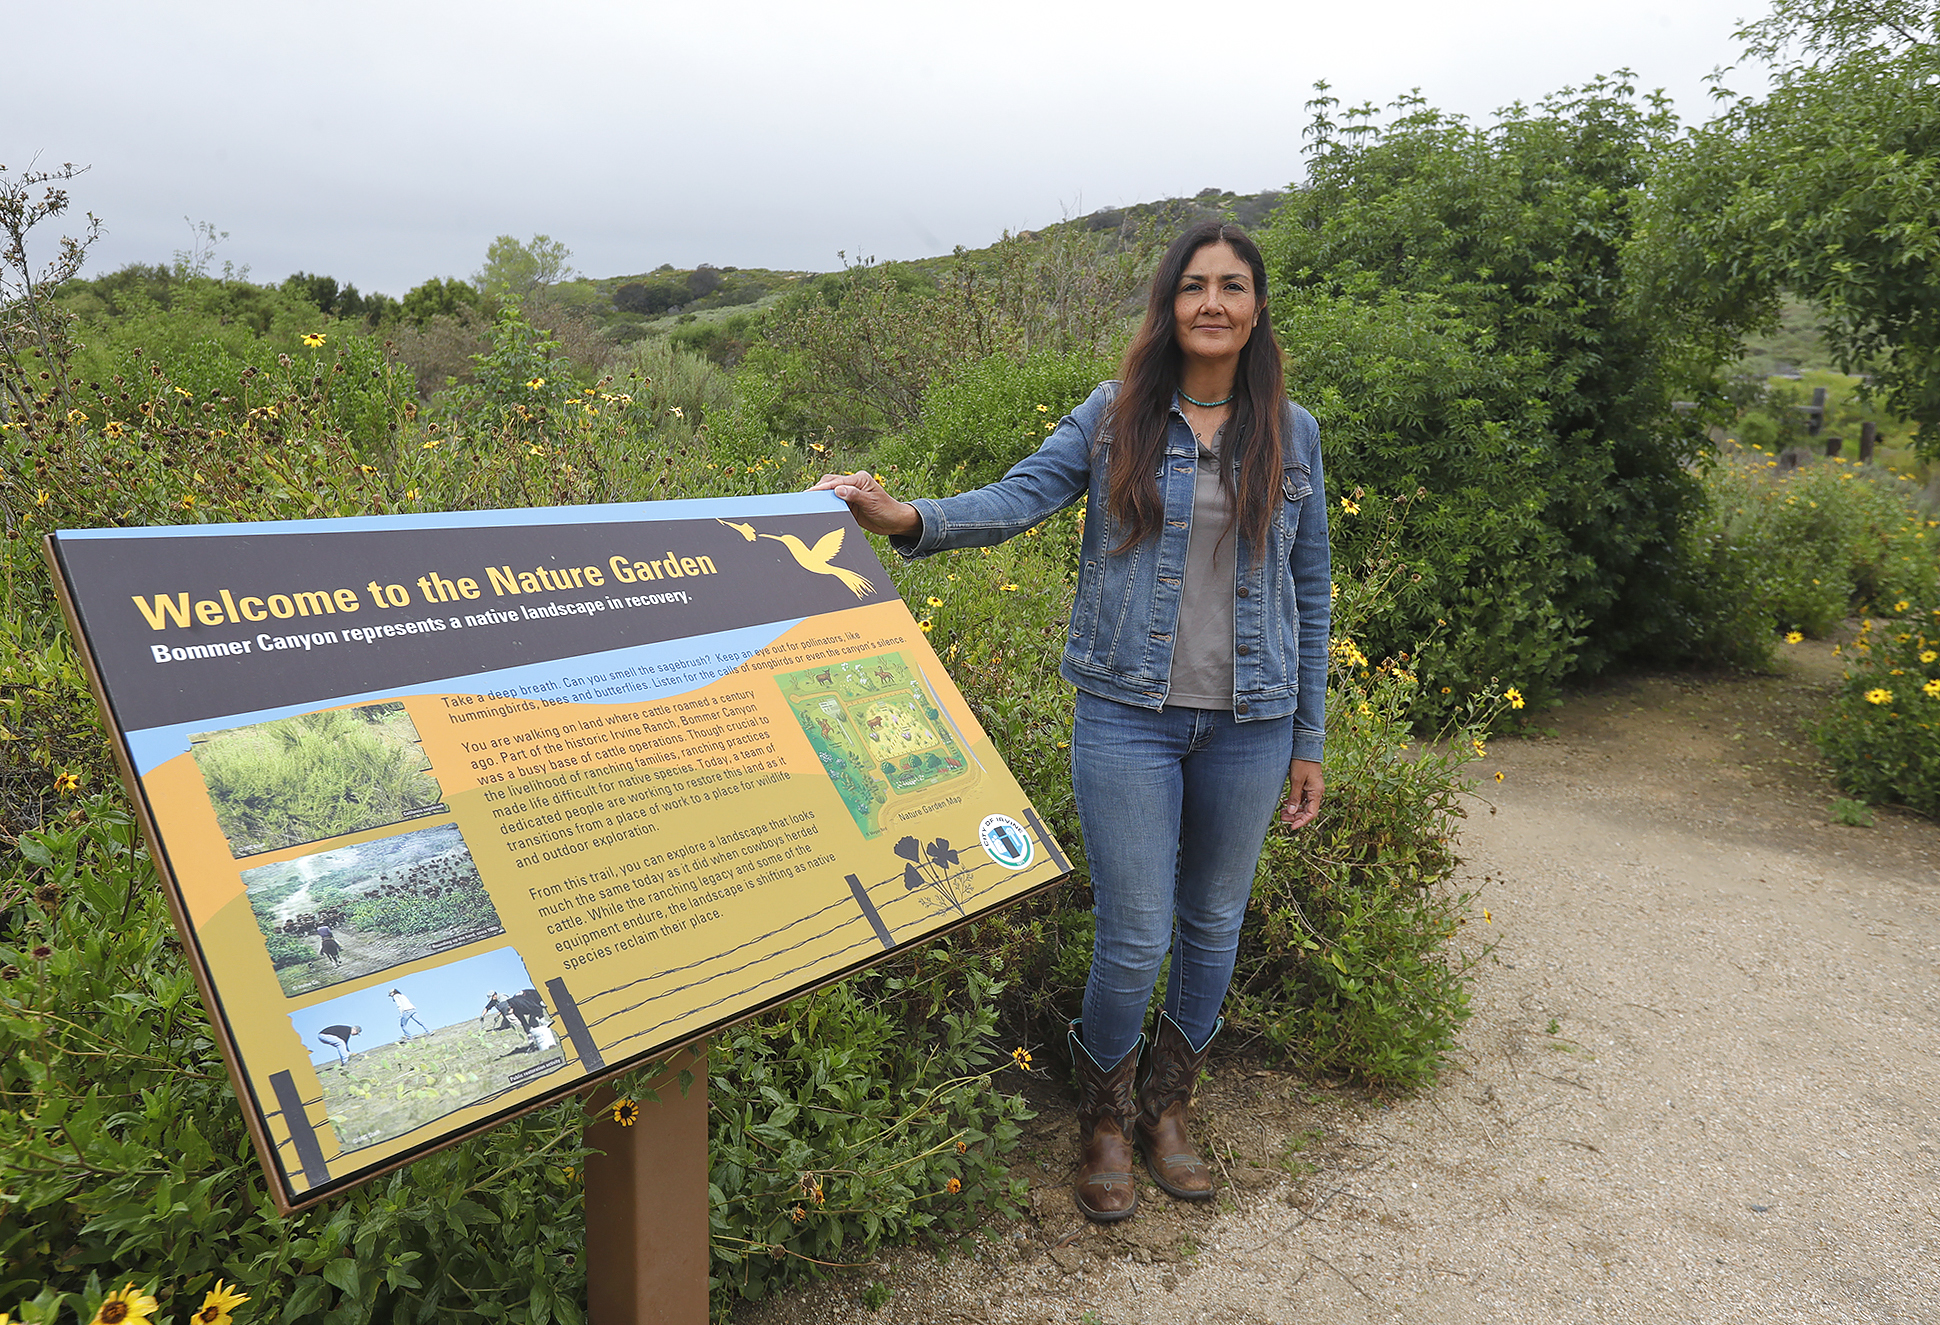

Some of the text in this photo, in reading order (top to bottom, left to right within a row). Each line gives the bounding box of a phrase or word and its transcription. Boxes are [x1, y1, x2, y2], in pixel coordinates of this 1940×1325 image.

[132, 551, 718, 631] Welcome to the Nature Garden
[151, 591, 692, 663] Bommer Canyon represents a native landscape in recovery.
[441, 632, 860, 708] Take a deep breath. Can you smell the sagebrush? Keep an eye out for pollinators, like
[449, 637, 907, 724] hummingbirds, bees and butterflies. Listen for the calls of songbirds or even the canyon's silence.
[461, 691, 754, 753] You are walking on land where cattle roamed a century
[470, 704, 758, 770] ago. Part of the historic Irvine Ranch, Bommer Canyon
[476, 716, 770, 785] was a busy base of cattle operations. Though crucial to
[484, 731, 770, 802] the livelihood of ranching families, ranching practices
[492, 742, 776, 818] made life difficult for native species. Today, a team of
[500, 756, 787, 835] dedicated people are working to restore this land as it
[898, 796, 962, 821] Nature Garden Map
[985, 818, 994, 827] OF
[996, 817, 1023, 834] IRVINE
[529, 810, 815, 900] From this trail, you can explore a landscape that looks
[538, 824, 819, 917] much the same today as it did when cowboys herded
[547, 844, 812, 934] cattle. While the ranching legacy and some of the
[555, 854, 836, 952] equipment endure, the landscape is shifting as native
[563, 910, 723, 970] species reclaim their place.
